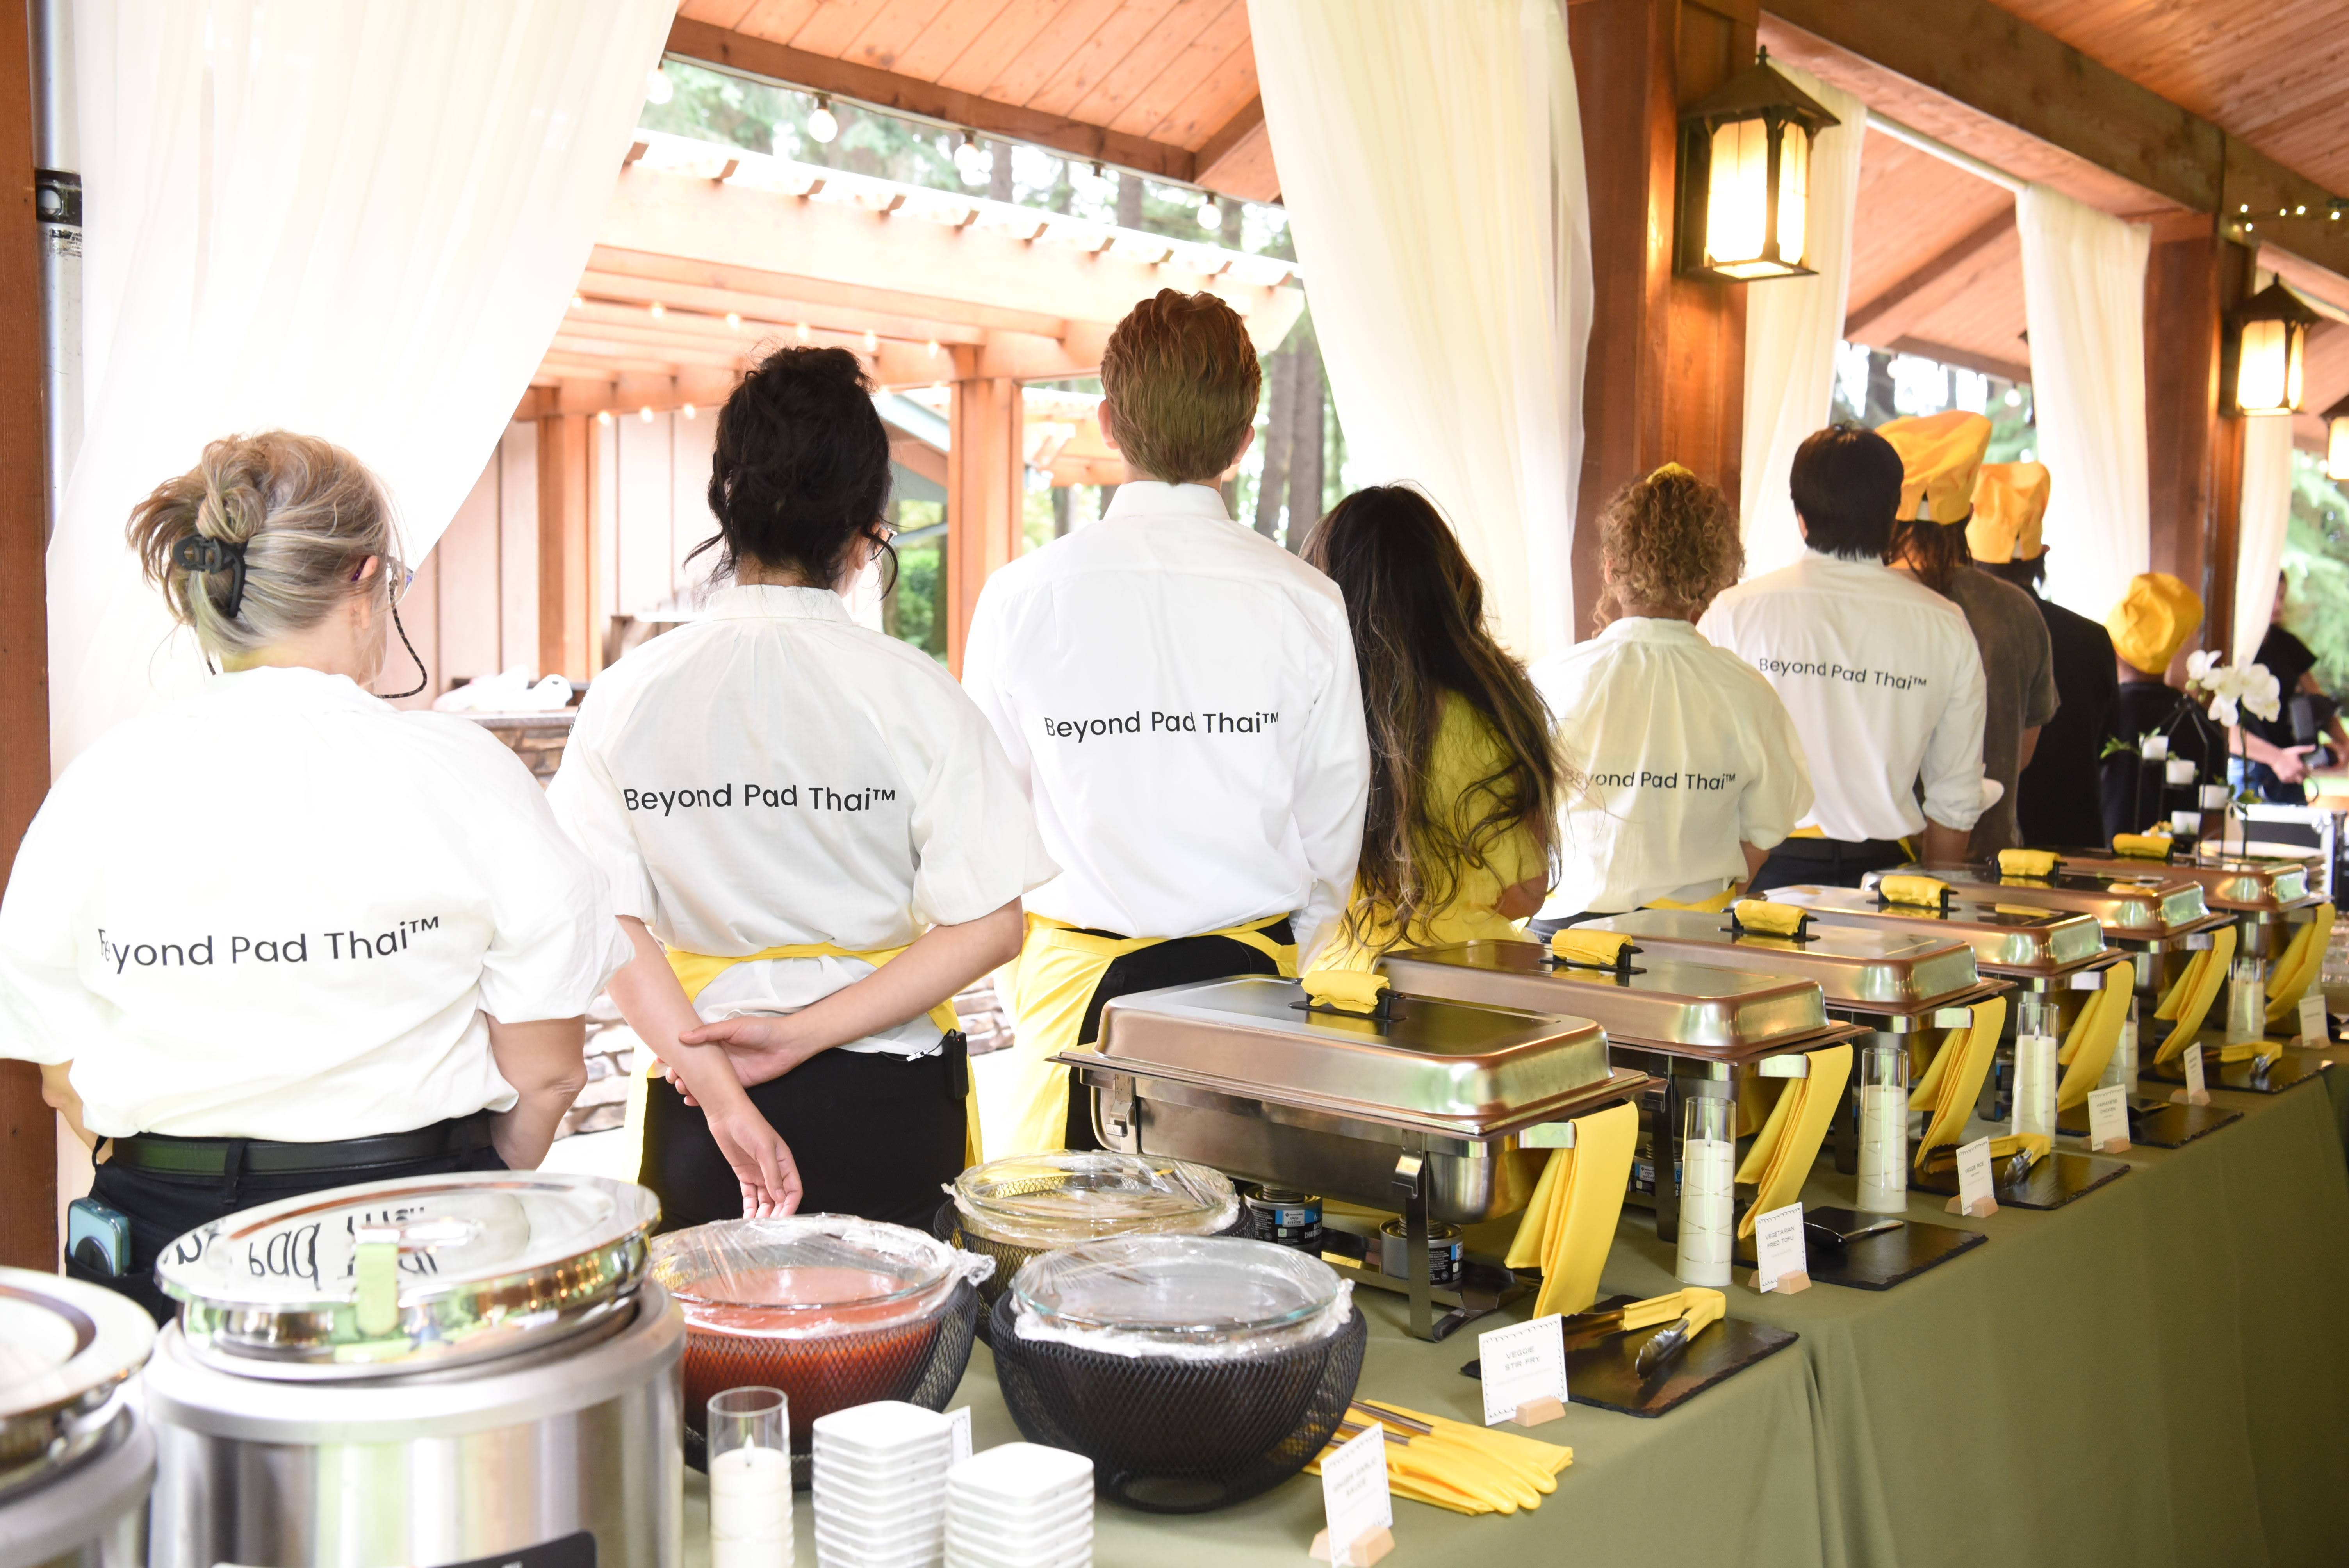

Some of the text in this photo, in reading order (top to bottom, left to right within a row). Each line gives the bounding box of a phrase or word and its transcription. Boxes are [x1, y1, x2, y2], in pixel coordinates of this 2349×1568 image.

[1759, 658, 1826, 677] Beyond
[1831, 664, 1867, 683] Pad
[1044, 711, 1140, 743] Beyond
[1151, 711, 1196, 732] Pad
[1641, 772, 1677, 789] Pad
[623, 783, 731, 817] Beyond
[745, 784, 797, 807] Pad
[232, 933, 307, 964] Pad
[1765, 1226, 1795, 1240] VEGETARIAN
[1767, 1236, 1794, 1249] FRIED TOFU
[1506, 1346, 1535, 1360] VEGGIE
[1504, 1356, 1540, 1371] STIR FRY
